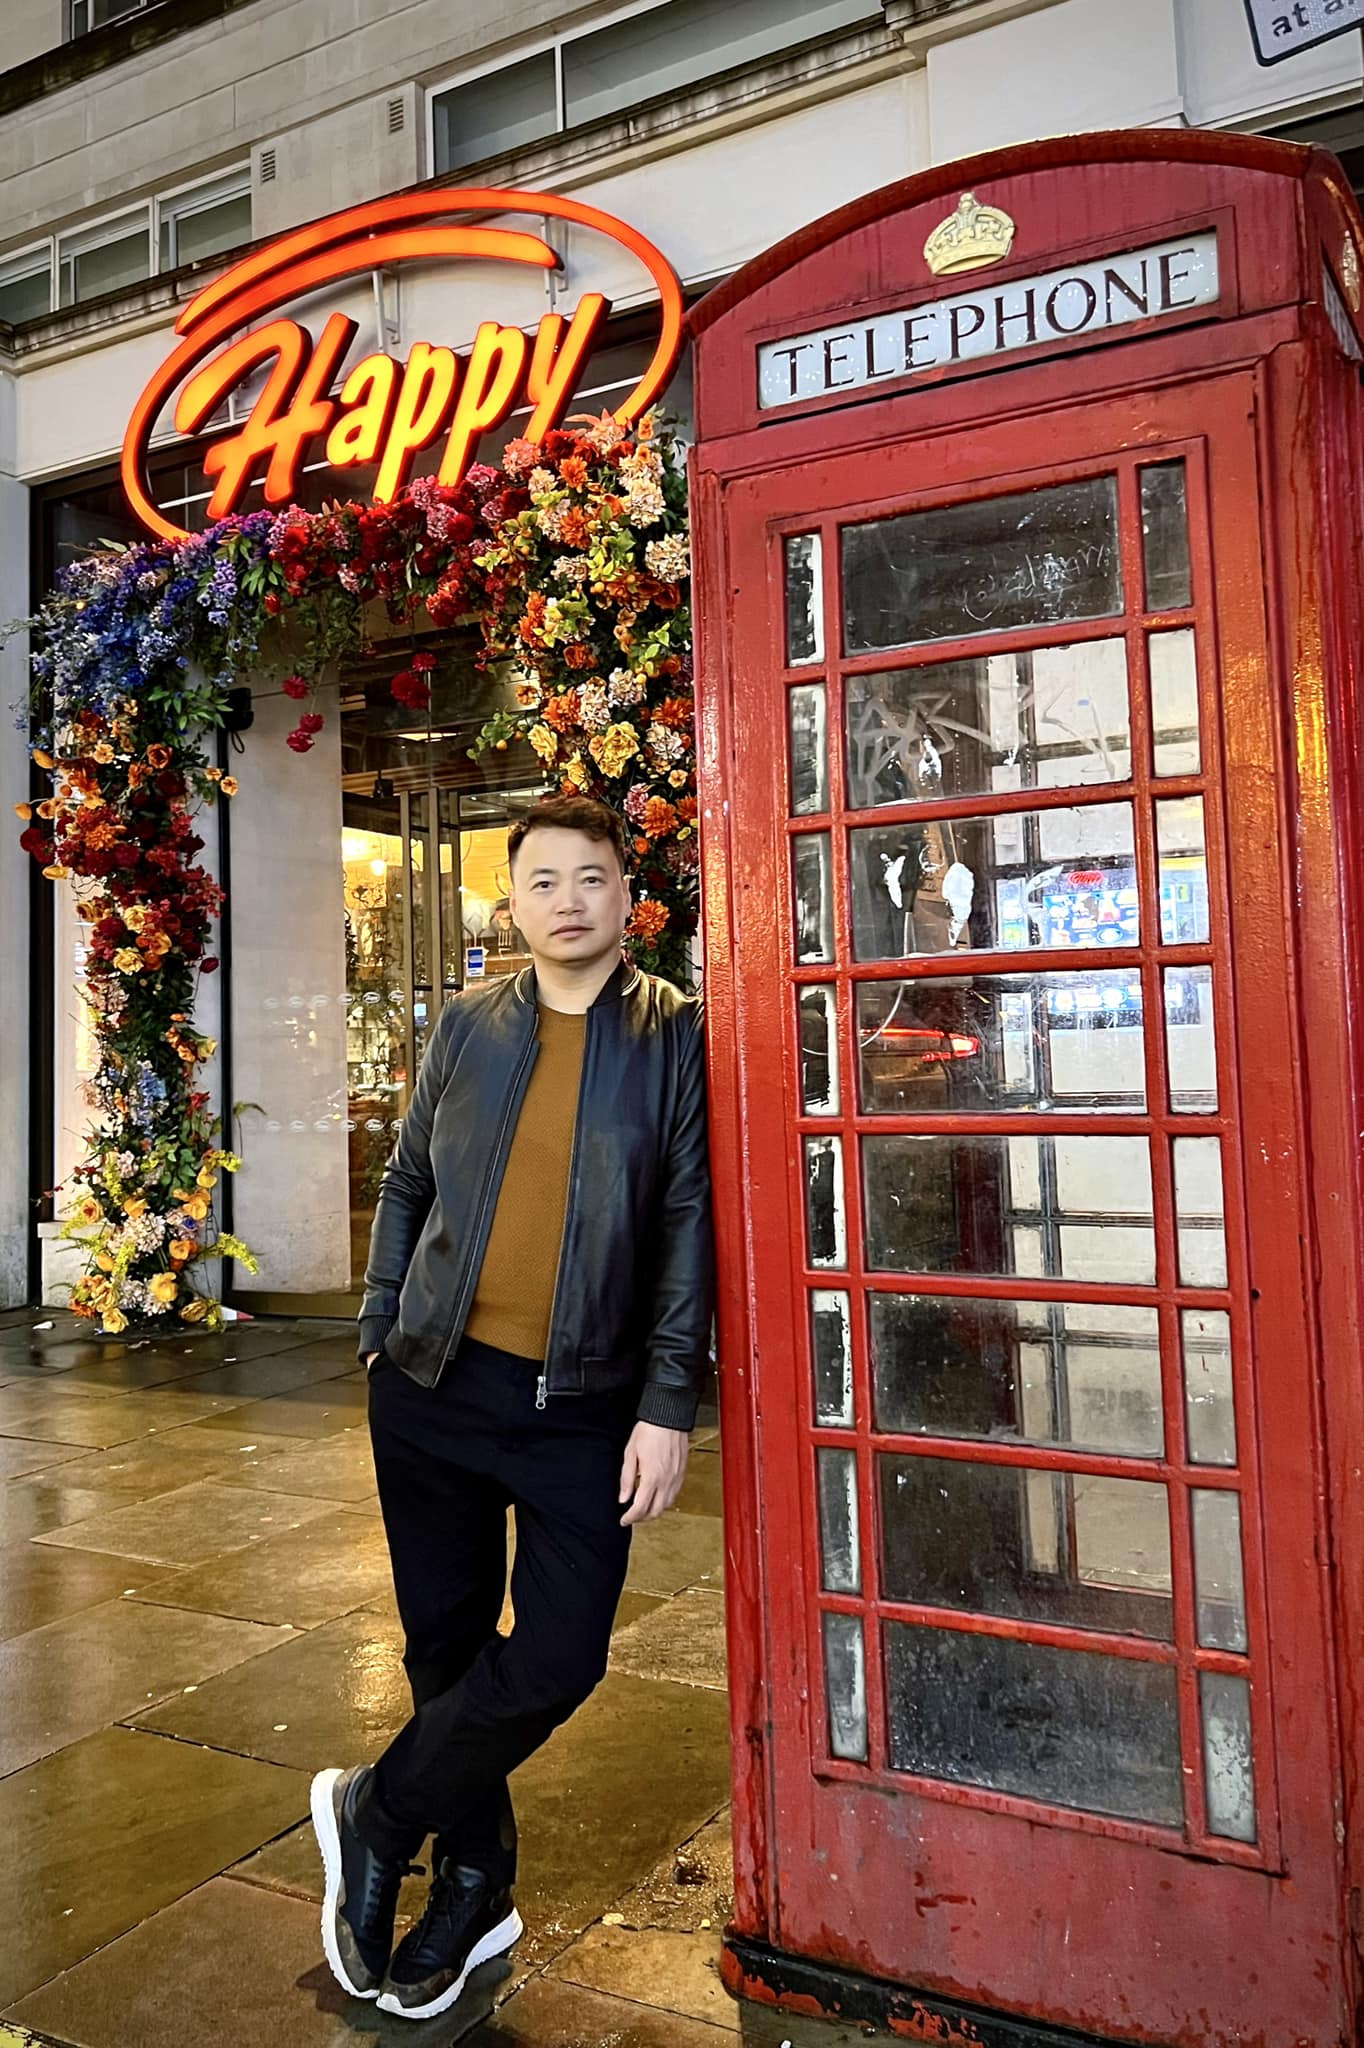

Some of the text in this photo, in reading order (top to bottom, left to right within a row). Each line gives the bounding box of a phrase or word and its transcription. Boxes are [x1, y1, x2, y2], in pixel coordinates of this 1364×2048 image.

[1271, 2, 1310, 37] at
[772, 247, 1198, 397] TELEPHONE
[174, 292, 612, 520] Happy
